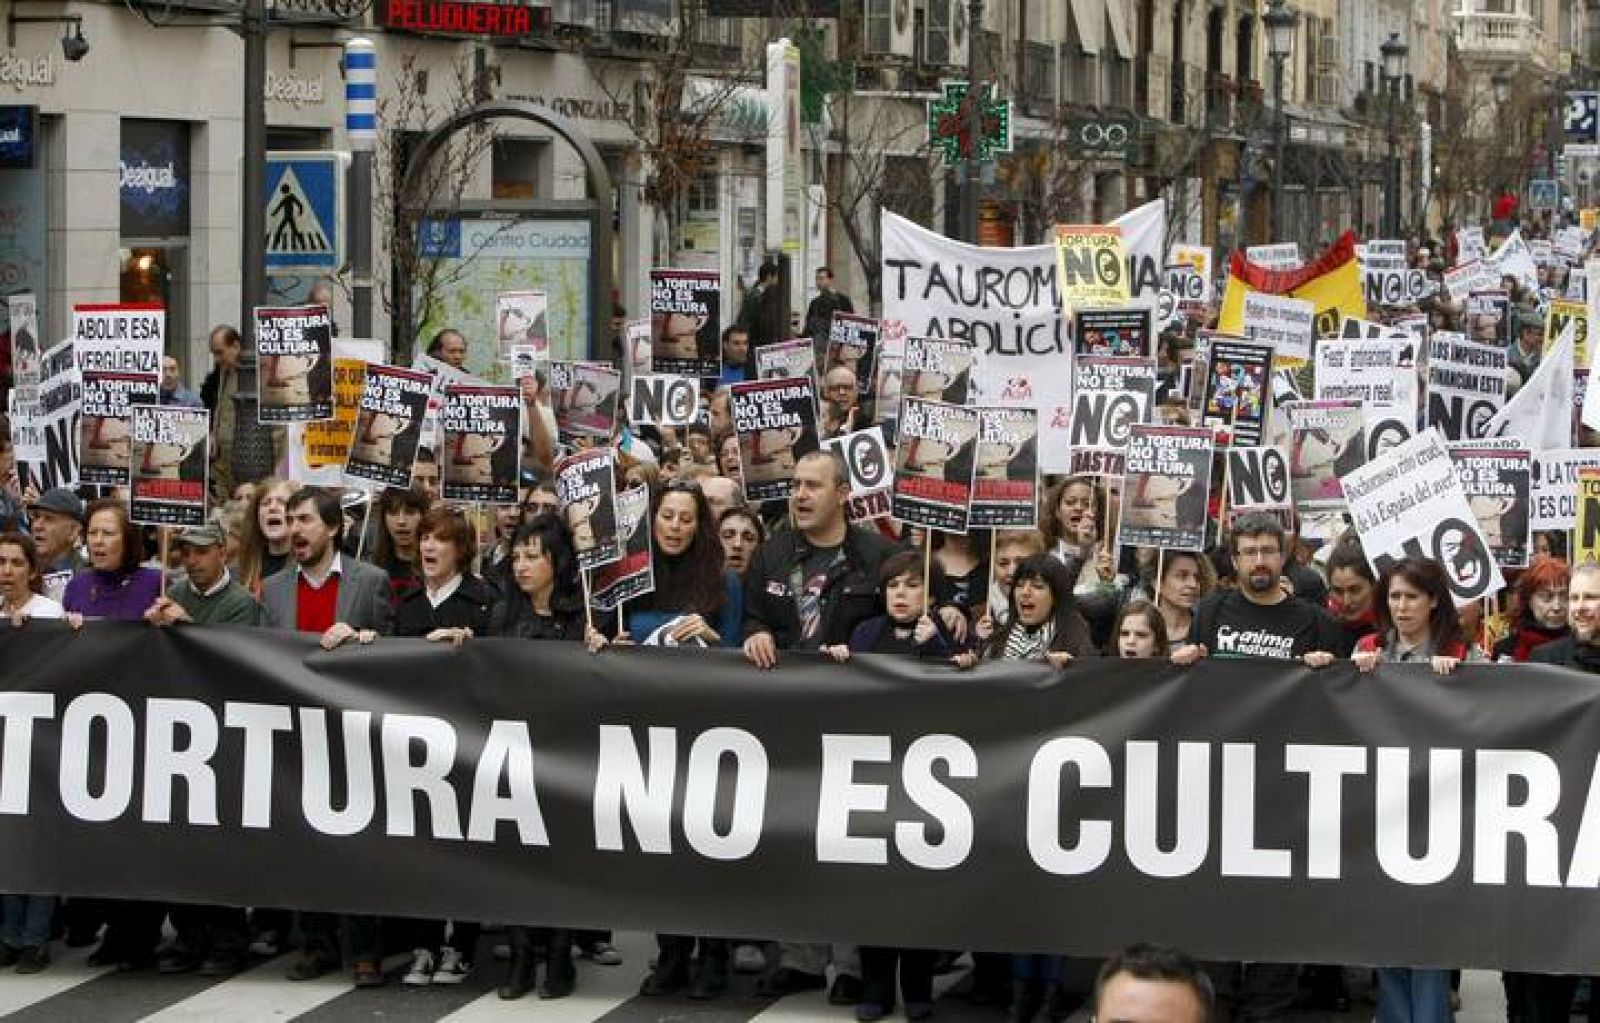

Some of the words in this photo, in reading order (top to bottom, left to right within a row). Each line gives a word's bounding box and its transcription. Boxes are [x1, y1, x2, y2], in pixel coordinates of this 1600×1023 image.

[1063, 248, 1121, 287] NO
[653, 280, 665, 290] LA
[664, 278, 720, 291] TORTURA
[653, 289, 672, 300] NO
[676, 290, 693, 301] ES
[653, 301, 708, 314] CULTURA
[77, 316, 128, 340] ABOLIR
[131, 316, 160, 340] ESA
[259, 320, 271, 329] LA
[270, 314, 330, 329] TORTURA
[259, 329, 279, 340] NO
[284, 329, 303, 341] ES
[259, 340, 319, 354] CULTURA
[446, 396, 460, 406] LA
[459, 394, 521, 408] TORTURA
[633, 378, 696, 423] NO
[732, 395, 748, 407] LA
[747, 387, 813, 405] TORTURA
[84, 403, 132, 416] CULTU
[444, 406, 465, 418] NO
[470, 407, 489, 419] ES
[734, 405, 759, 418] NO
[763, 401, 782, 415] ES
[445, 420, 506, 433] CULTURA
[737, 414, 802, 431] CULTURA
[1130, 436, 1145, 448] LA
[1146, 436, 1211, 451] TORTURA
[1128, 447, 1153, 459] NO
[1157, 448, 1179, 461] ES
[1128, 460, 1194, 476] CULTURA
[1465, 457, 1530, 471] TORTURA
[1230, 449, 1288, 506] NO
[1480, 470, 1498, 482] ES
[1462, 483, 1516, 495] ULTURA
[1539, 495, 1557, 519] ES
[1239, 628, 1294, 648] anima
[0, 691, 550, 848] TORTURA
[593, 723, 769, 862] NO
[815, 732, 979, 871] ES
